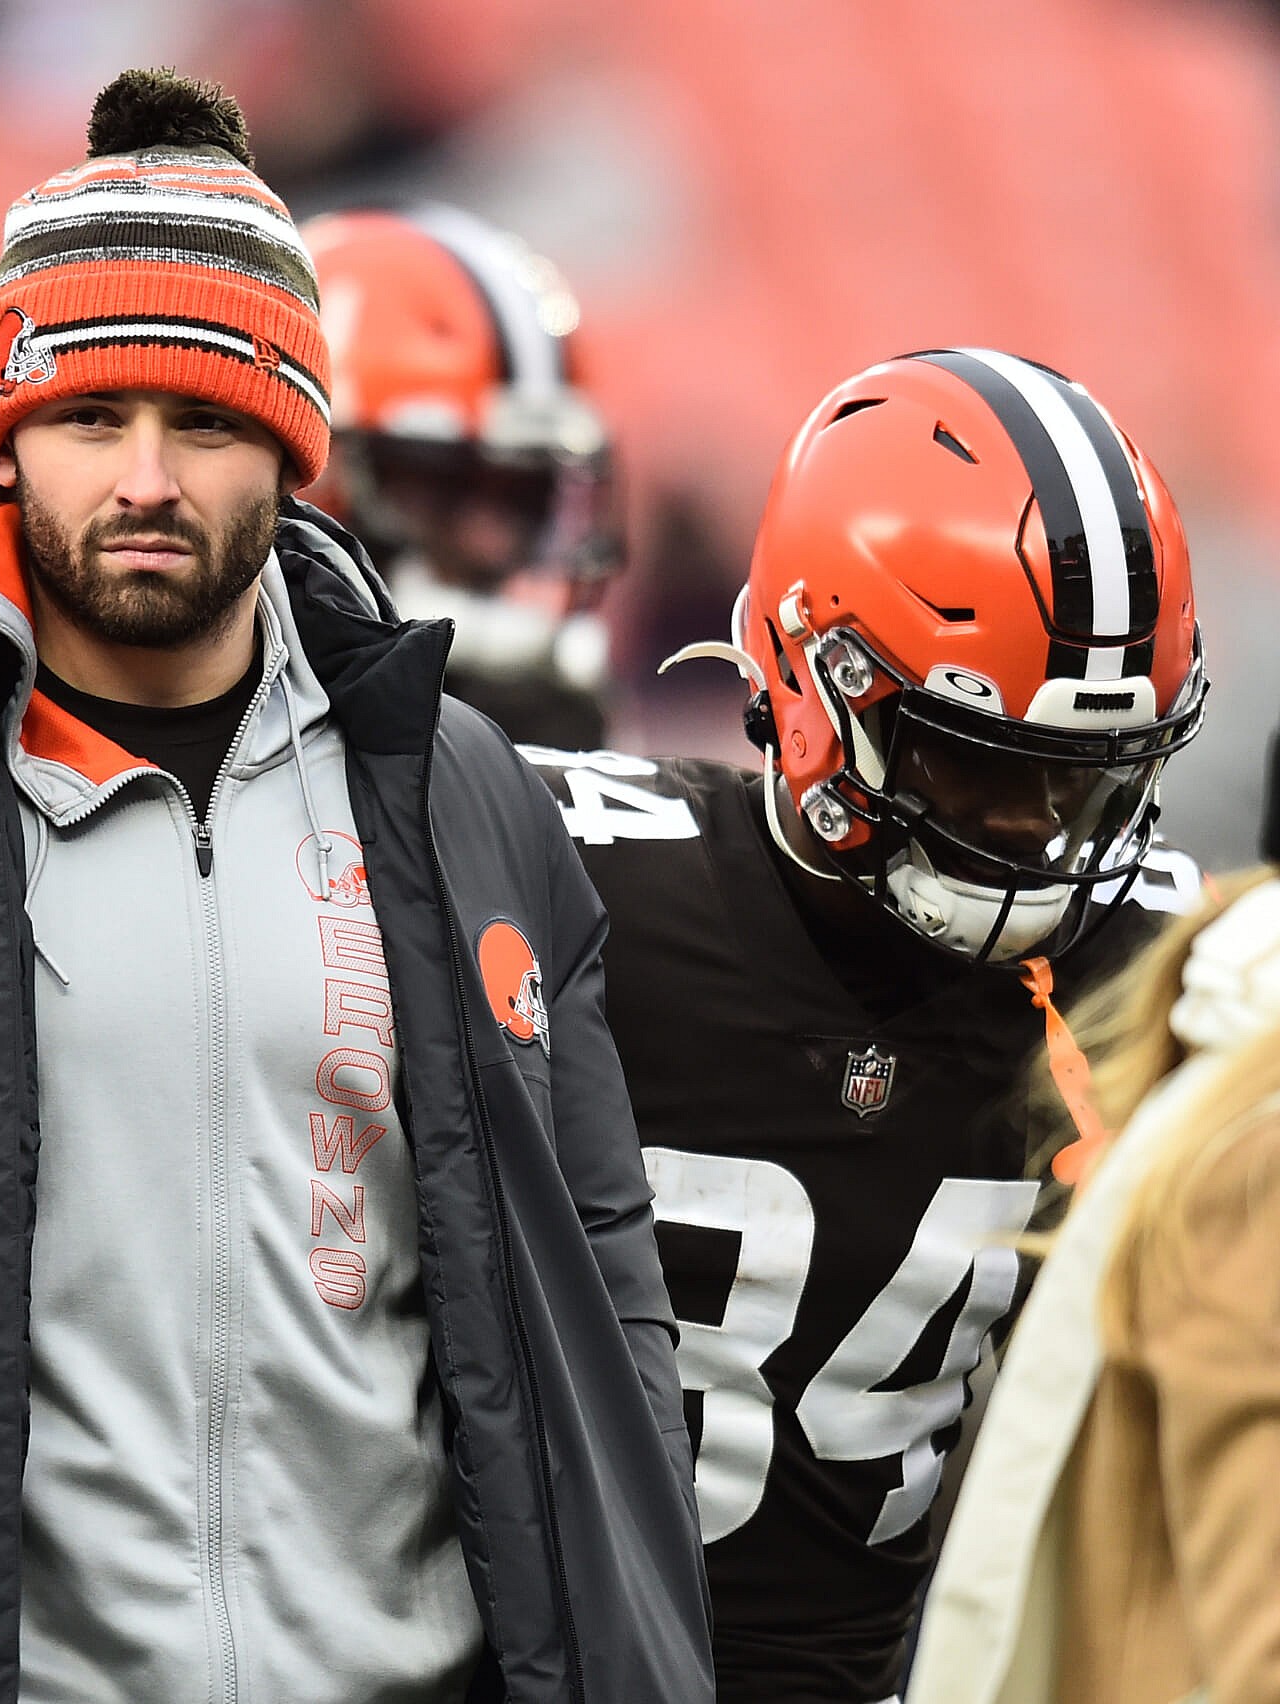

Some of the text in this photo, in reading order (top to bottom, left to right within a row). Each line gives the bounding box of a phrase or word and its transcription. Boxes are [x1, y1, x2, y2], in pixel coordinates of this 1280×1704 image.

[308, 915, 394, 1311] BROWNS
[848, 1077, 886, 1105] NFL
[641, 1147, 1042, 1547] 84
